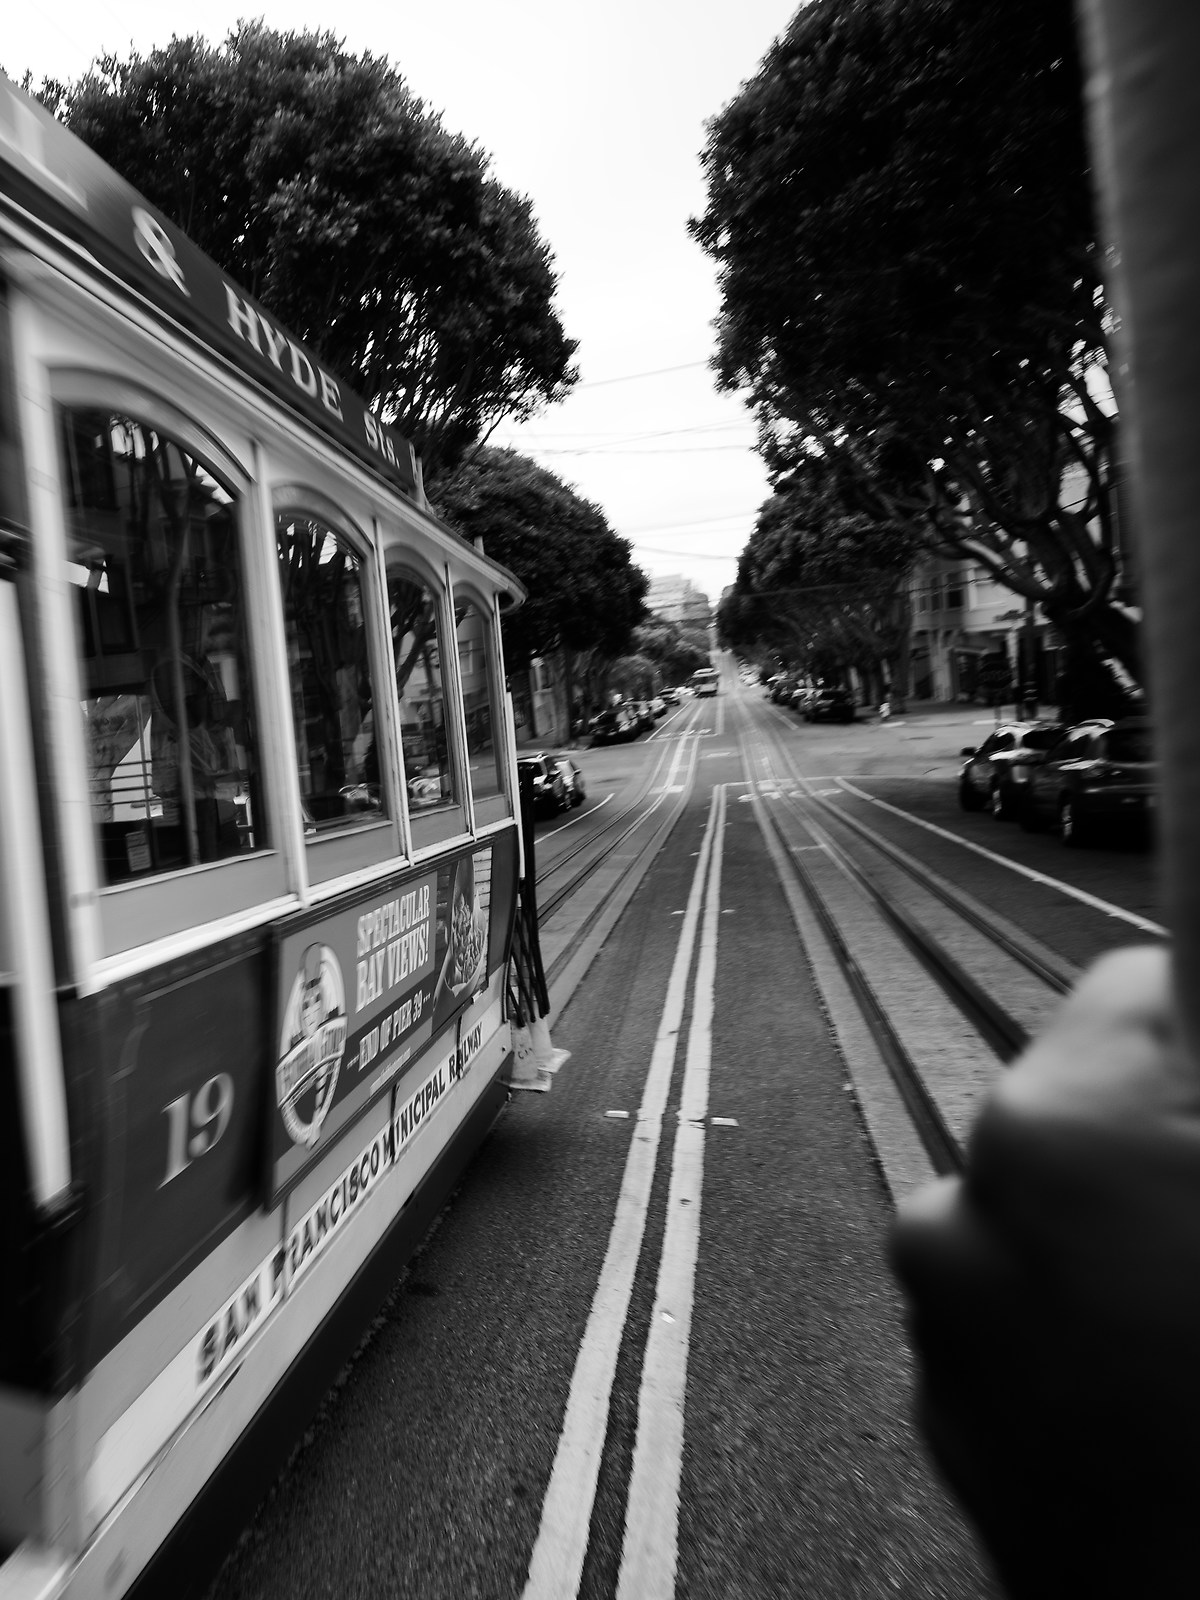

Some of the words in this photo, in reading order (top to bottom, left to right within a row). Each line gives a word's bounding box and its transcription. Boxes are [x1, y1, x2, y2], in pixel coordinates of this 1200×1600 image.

[222, 281, 344, 422] HYDE
[355, 947, 386, 1014] BAY
[387, 920, 430, 990] VIEWS!
[357, 885, 430, 959] SPECTACULAR
[392, 998, 412, 1041] PIER
[156, 1071, 235, 1191] 19
[197, 1272, 264, 1386] SAN
